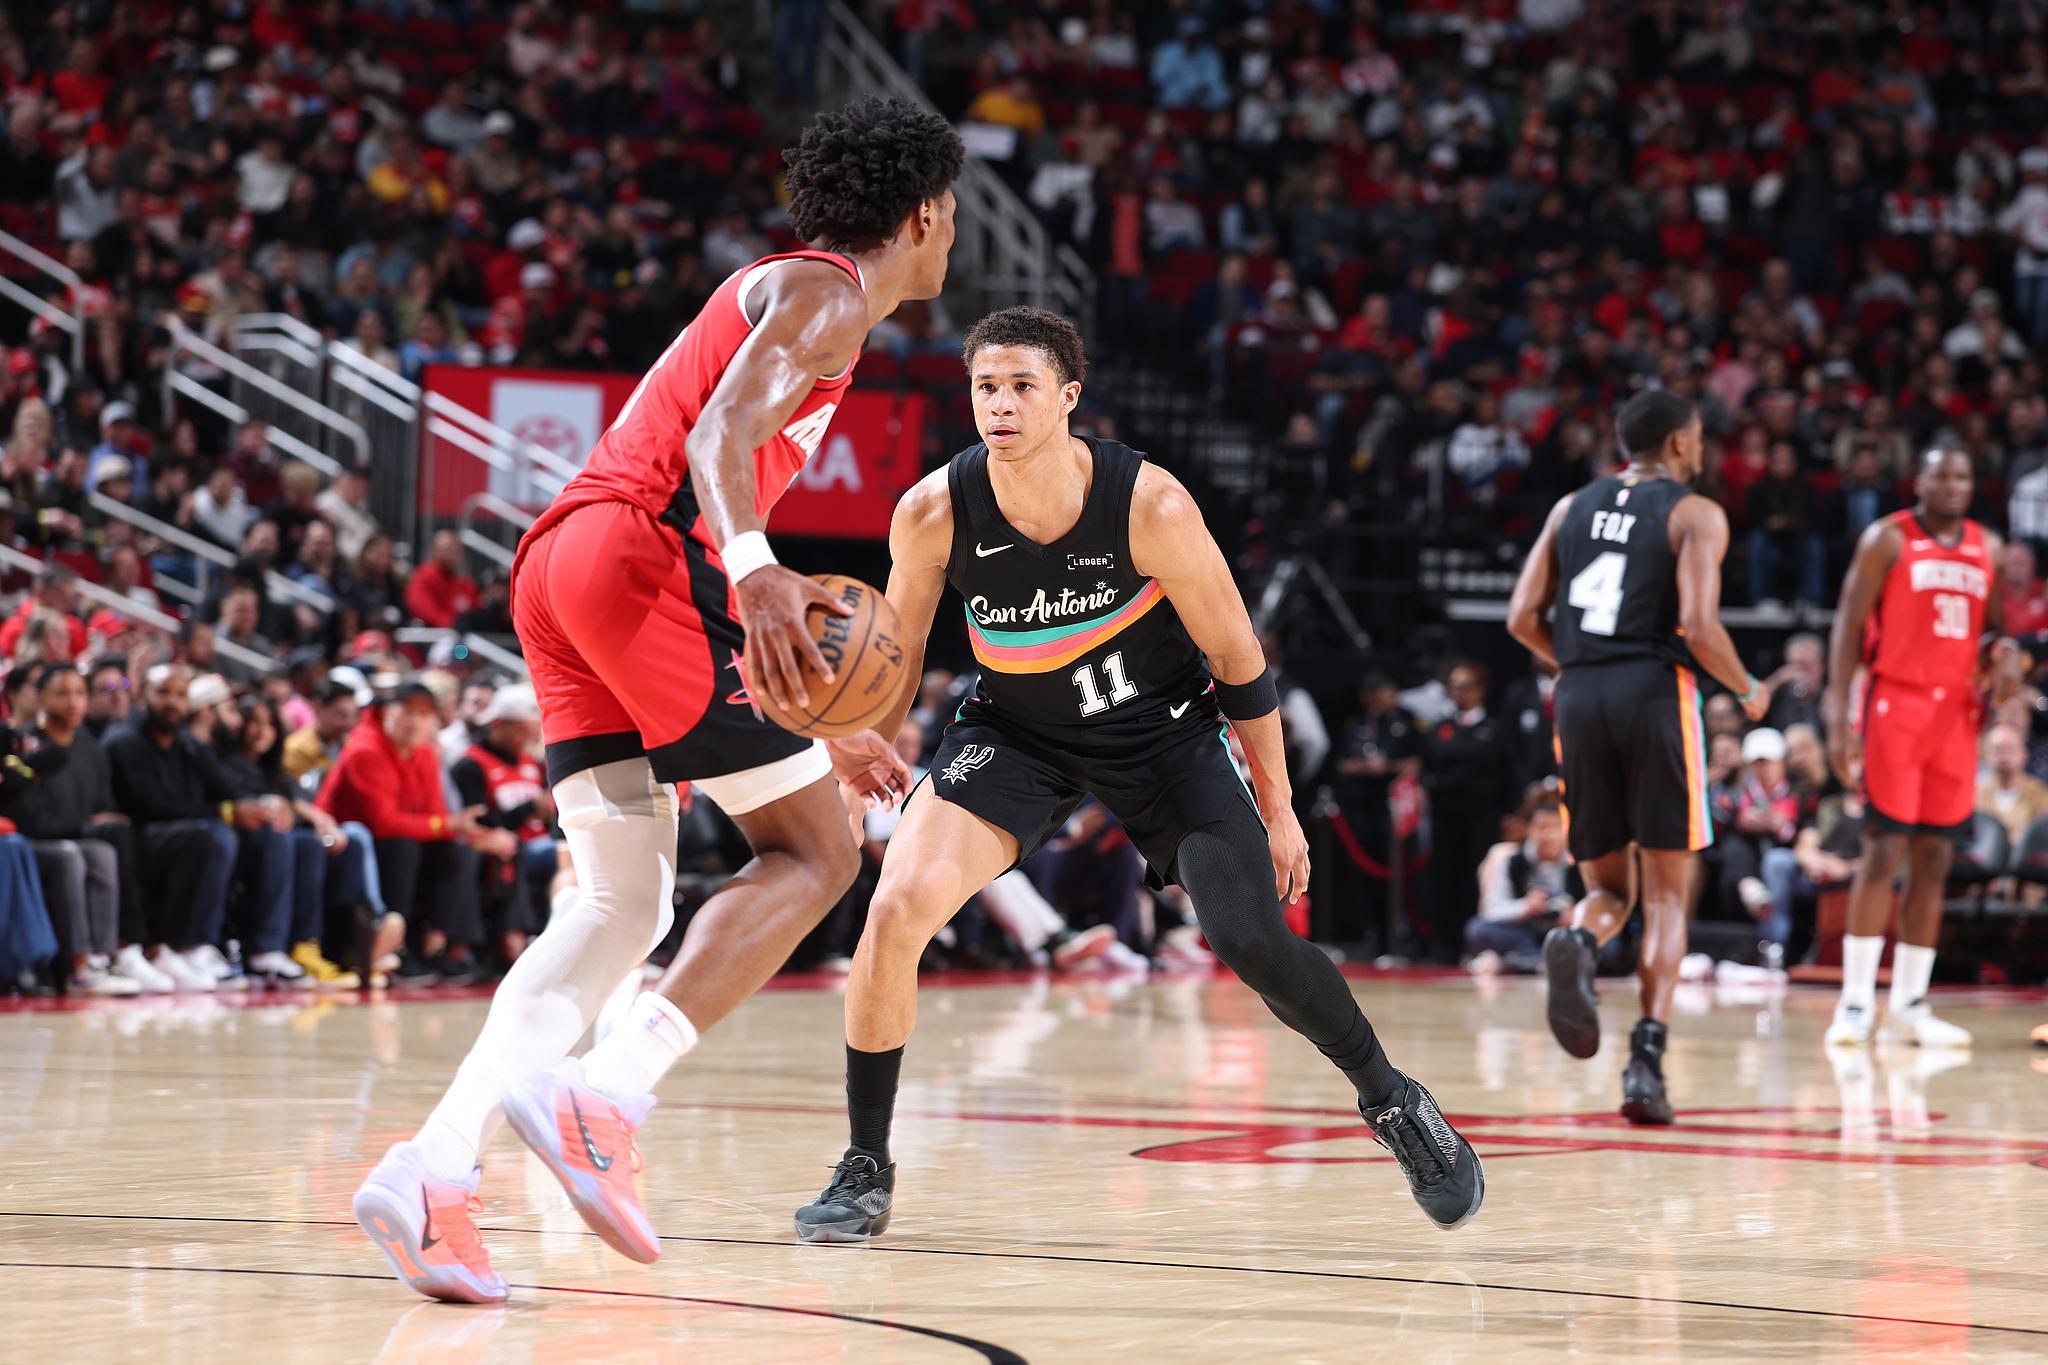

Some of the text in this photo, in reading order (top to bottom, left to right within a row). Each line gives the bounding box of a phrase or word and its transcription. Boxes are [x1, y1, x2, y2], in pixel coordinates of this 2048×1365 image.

[1590, 510, 1637, 544] FOX
[1073, 557, 1108, 566] LEDGER
[970, 581, 1119, 625] San Antonio
[1567, 551, 1627, 636] 4
[1933, 593, 1970, 640] 30
[1071, 651, 1139, 717] 11
